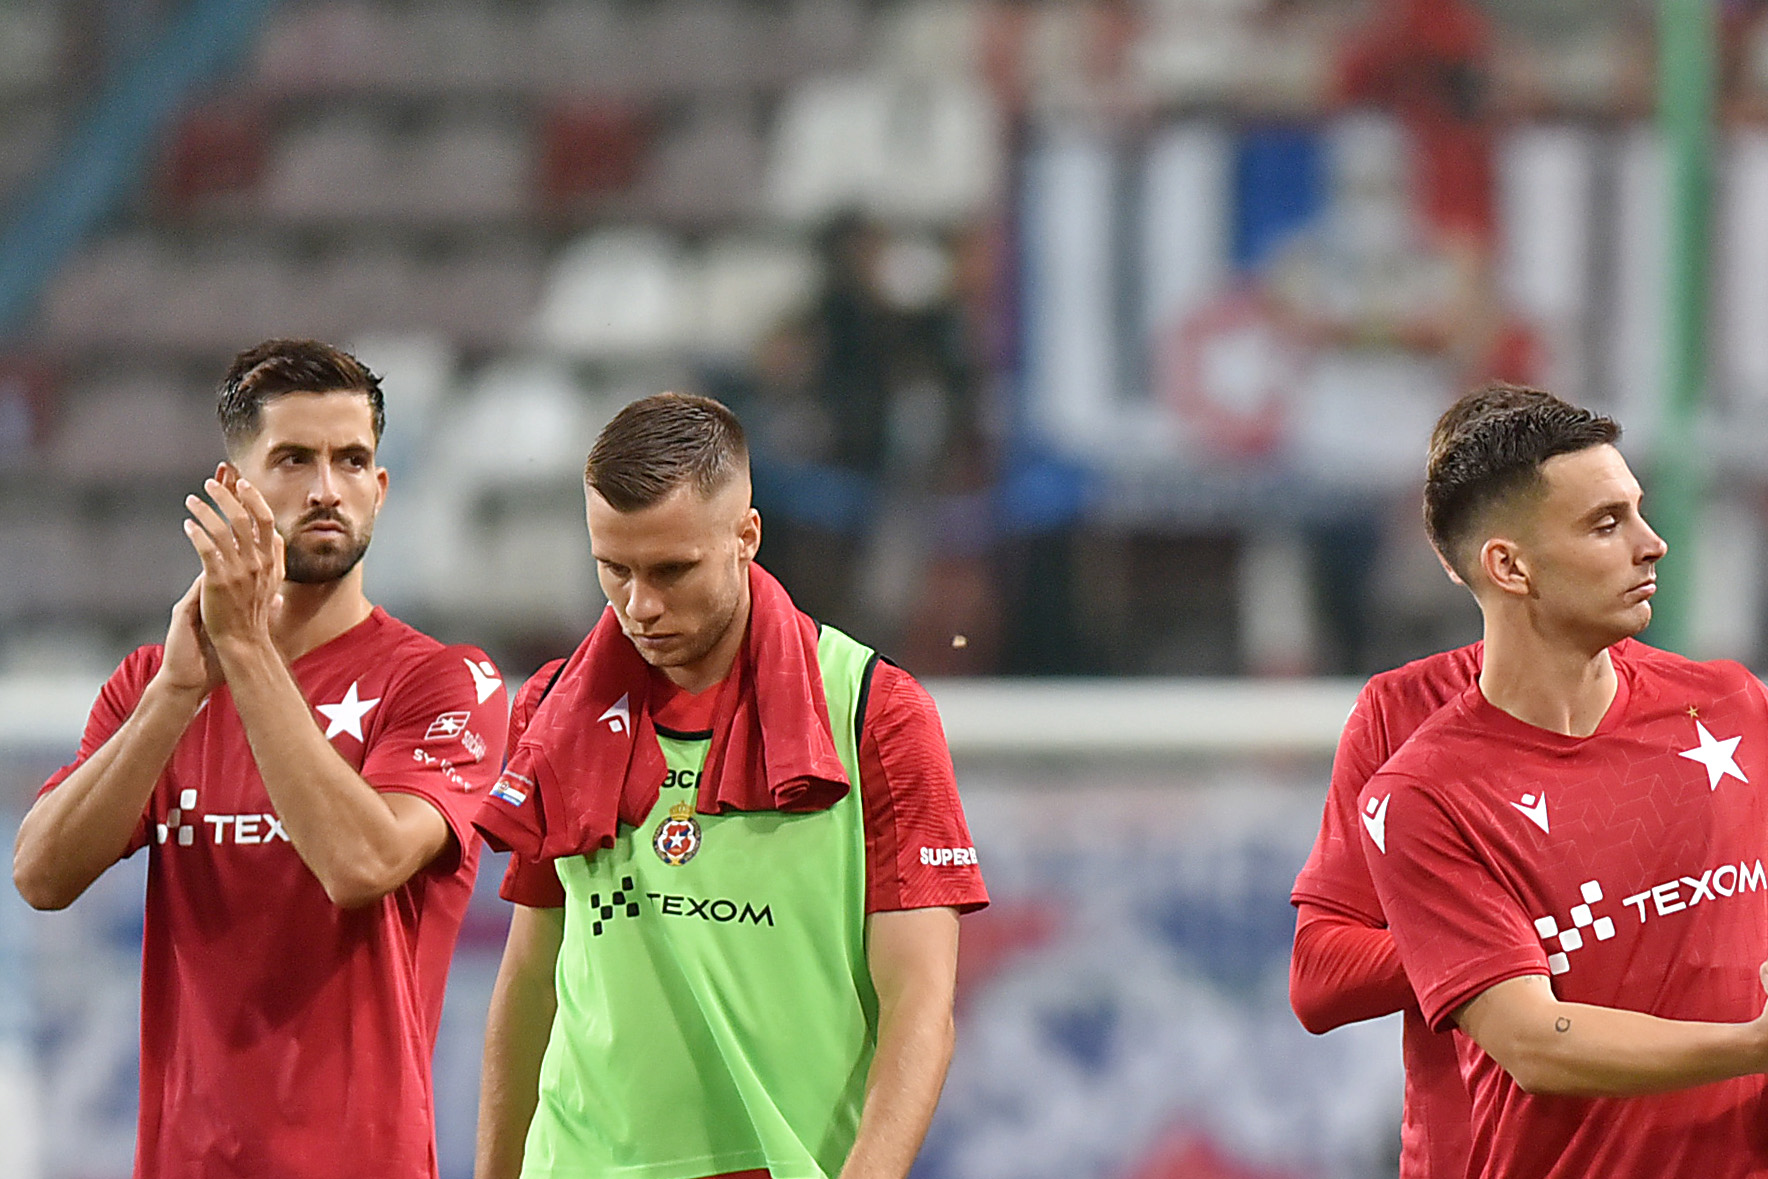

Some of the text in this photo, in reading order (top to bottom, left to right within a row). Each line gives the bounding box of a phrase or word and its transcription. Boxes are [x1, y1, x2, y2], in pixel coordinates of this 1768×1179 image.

[203, 814, 291, 844] TEX
[920, 846, 978, 866] SUPERB
[1622, 858, 1768, 924] TEXOM
[646, 893, 775, 927] TEXOM
